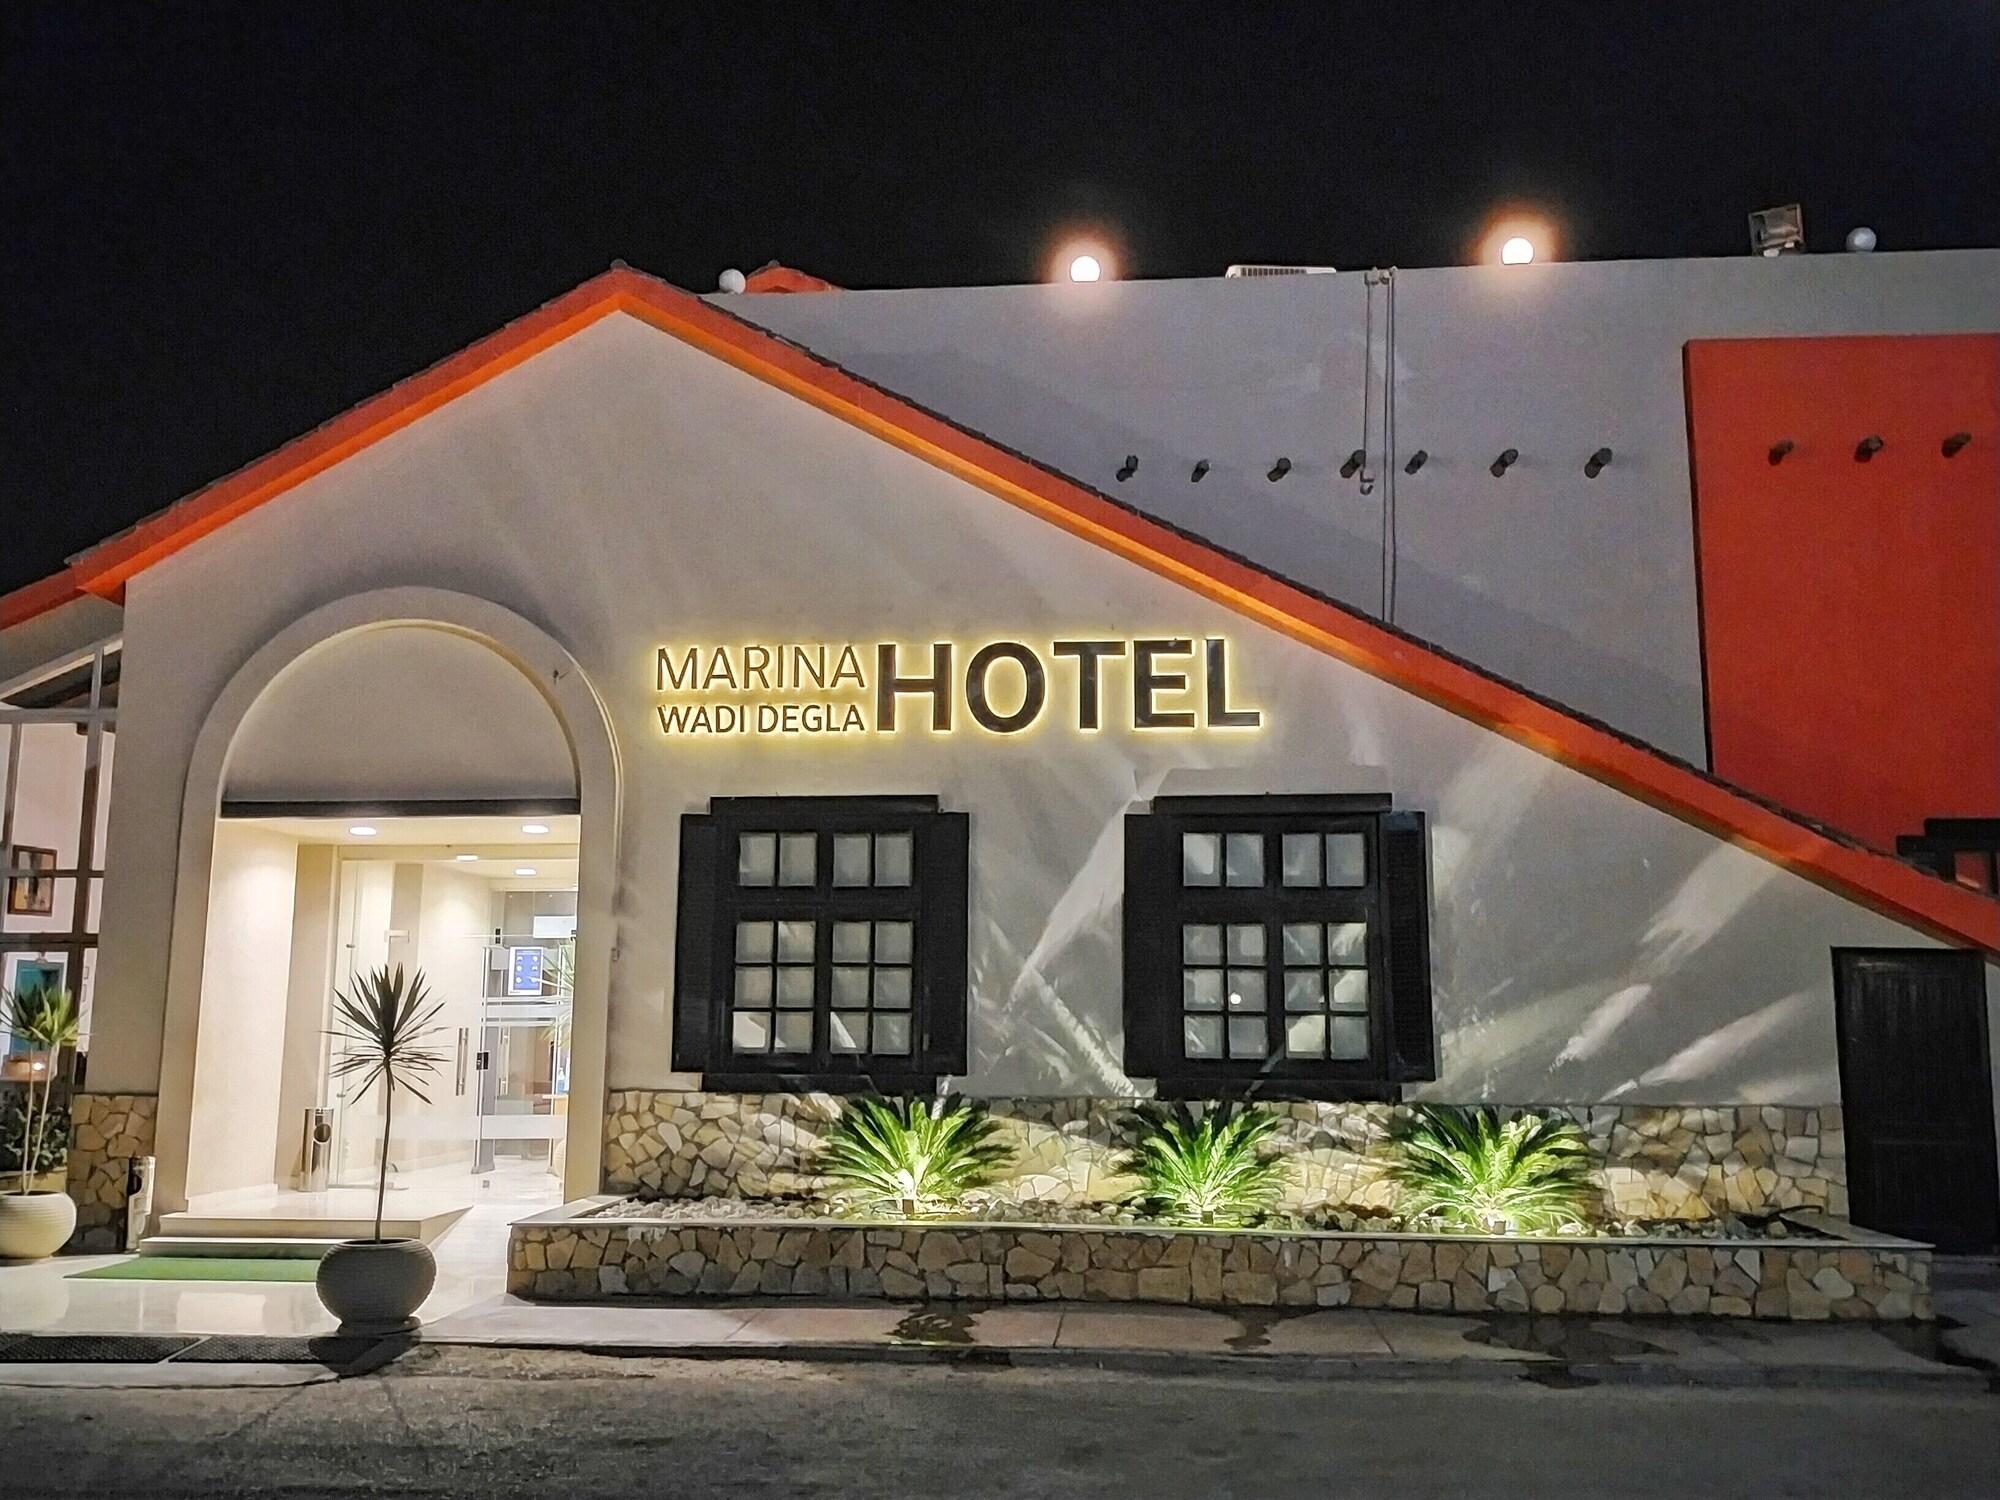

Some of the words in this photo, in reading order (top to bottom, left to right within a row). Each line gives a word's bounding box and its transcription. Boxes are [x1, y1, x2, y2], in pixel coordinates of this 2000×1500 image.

[656, 645, 866, 691] MARINA
[876, 638, 1261, 733] HOTEL
[657, 704, 747, 734] WADI
[757, 703, 866, 733] DEGLA
